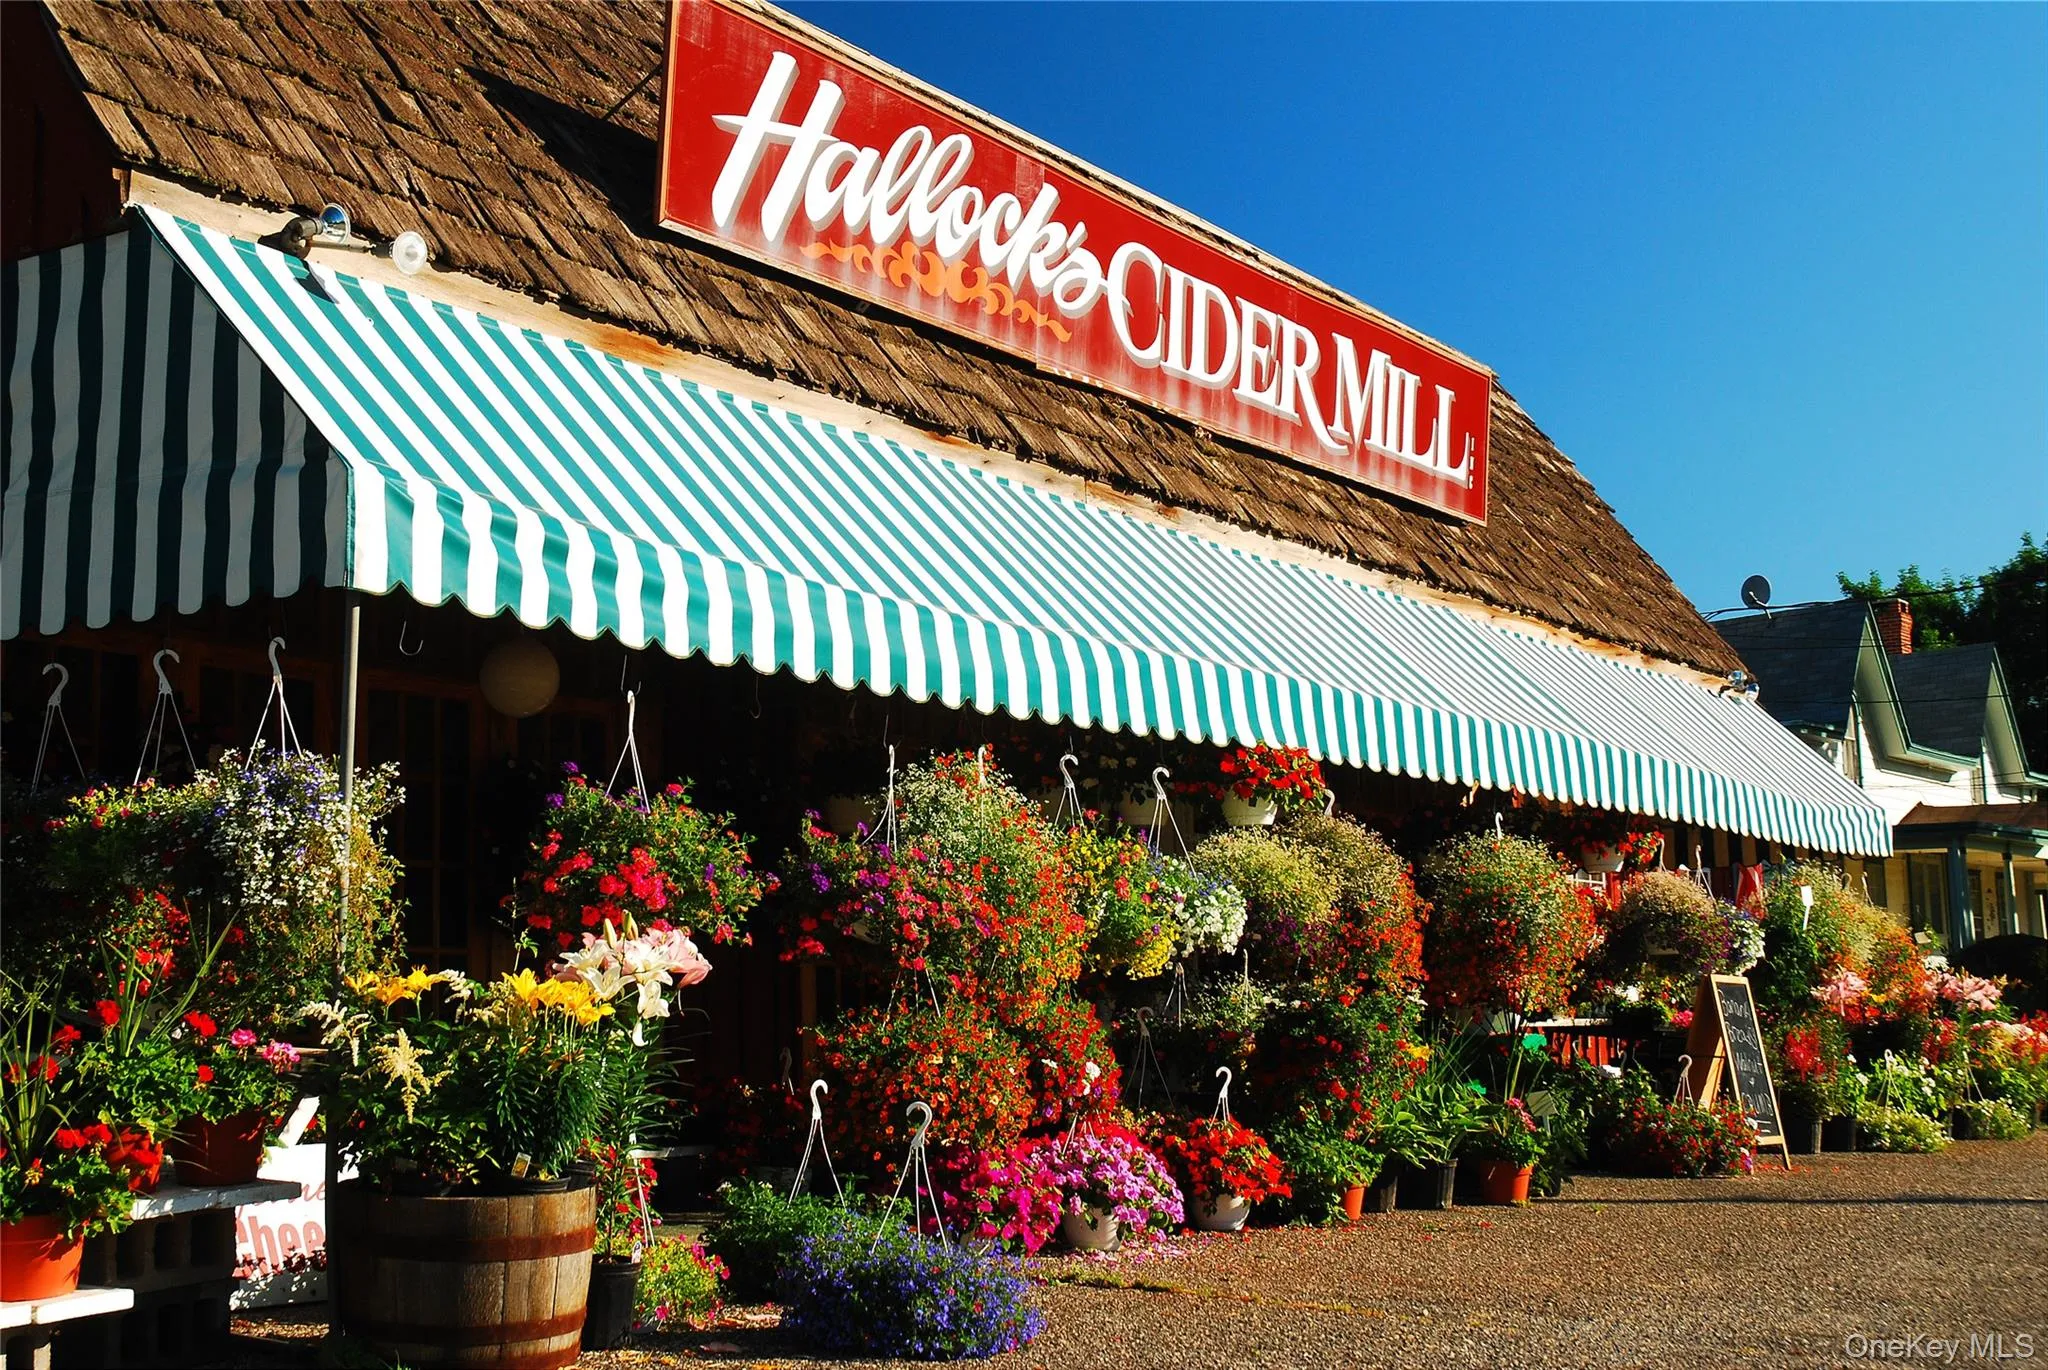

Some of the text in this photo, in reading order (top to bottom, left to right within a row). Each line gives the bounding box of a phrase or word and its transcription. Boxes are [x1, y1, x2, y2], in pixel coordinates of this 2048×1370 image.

[711, 50, 1469, 487] Hallock's CIDER MILL
